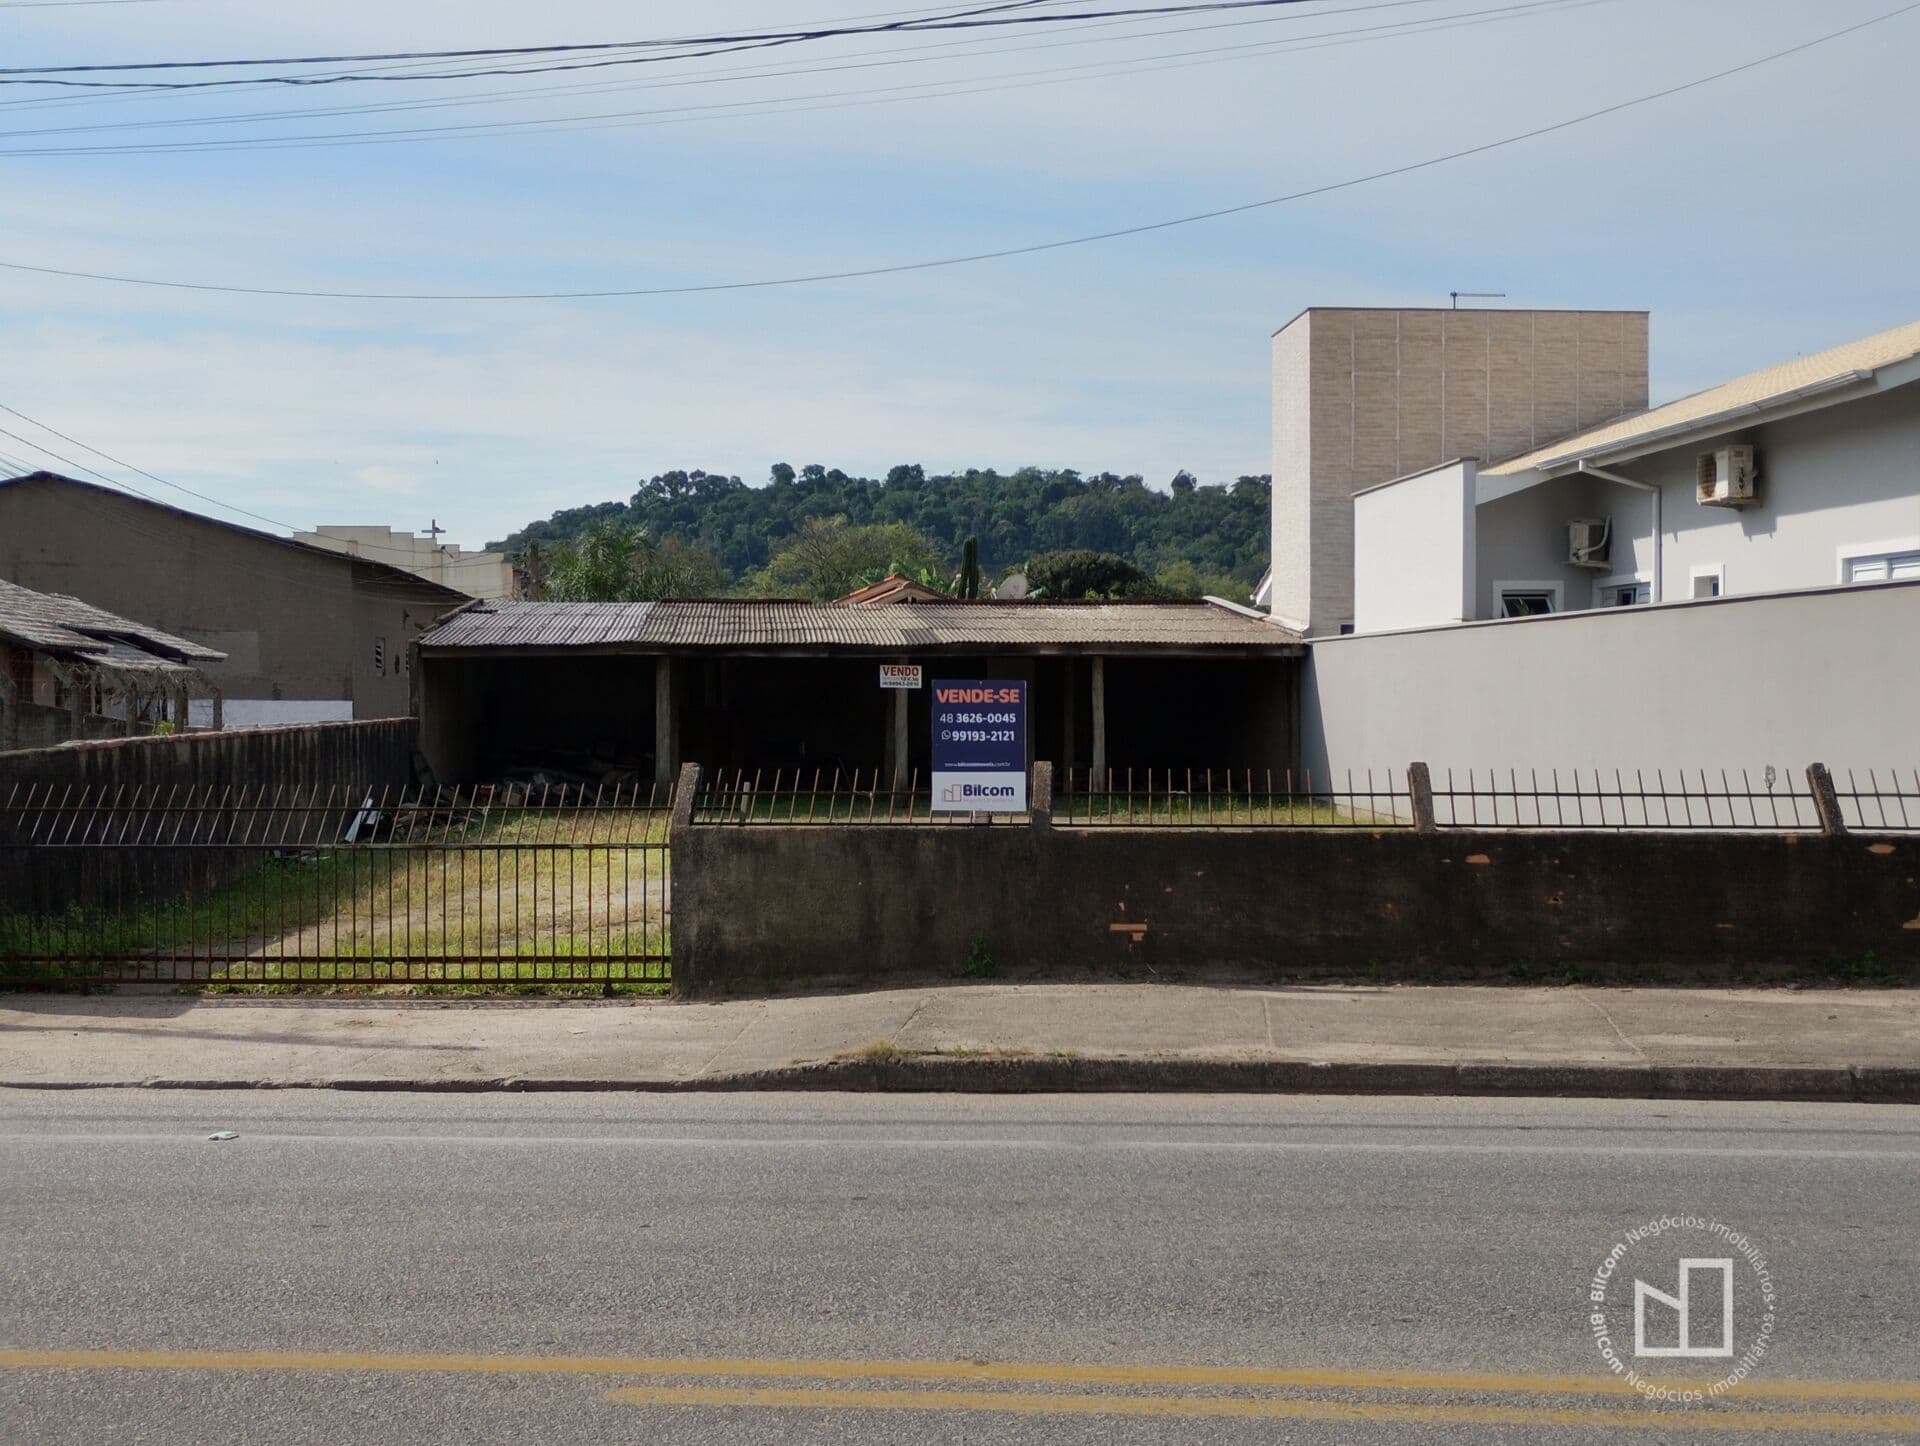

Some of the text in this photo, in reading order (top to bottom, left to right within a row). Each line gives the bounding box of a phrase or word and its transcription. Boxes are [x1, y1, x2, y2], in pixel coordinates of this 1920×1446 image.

[882, 666, 919, 677] VENDO
[936, 688, 1020, 704] VENDE-SE
[939, 713, 1017, 724] 48 3626-0045
[952, 730, 1015, 742] 99193-2121
[963, 784, 1015, 797] Bilcom
